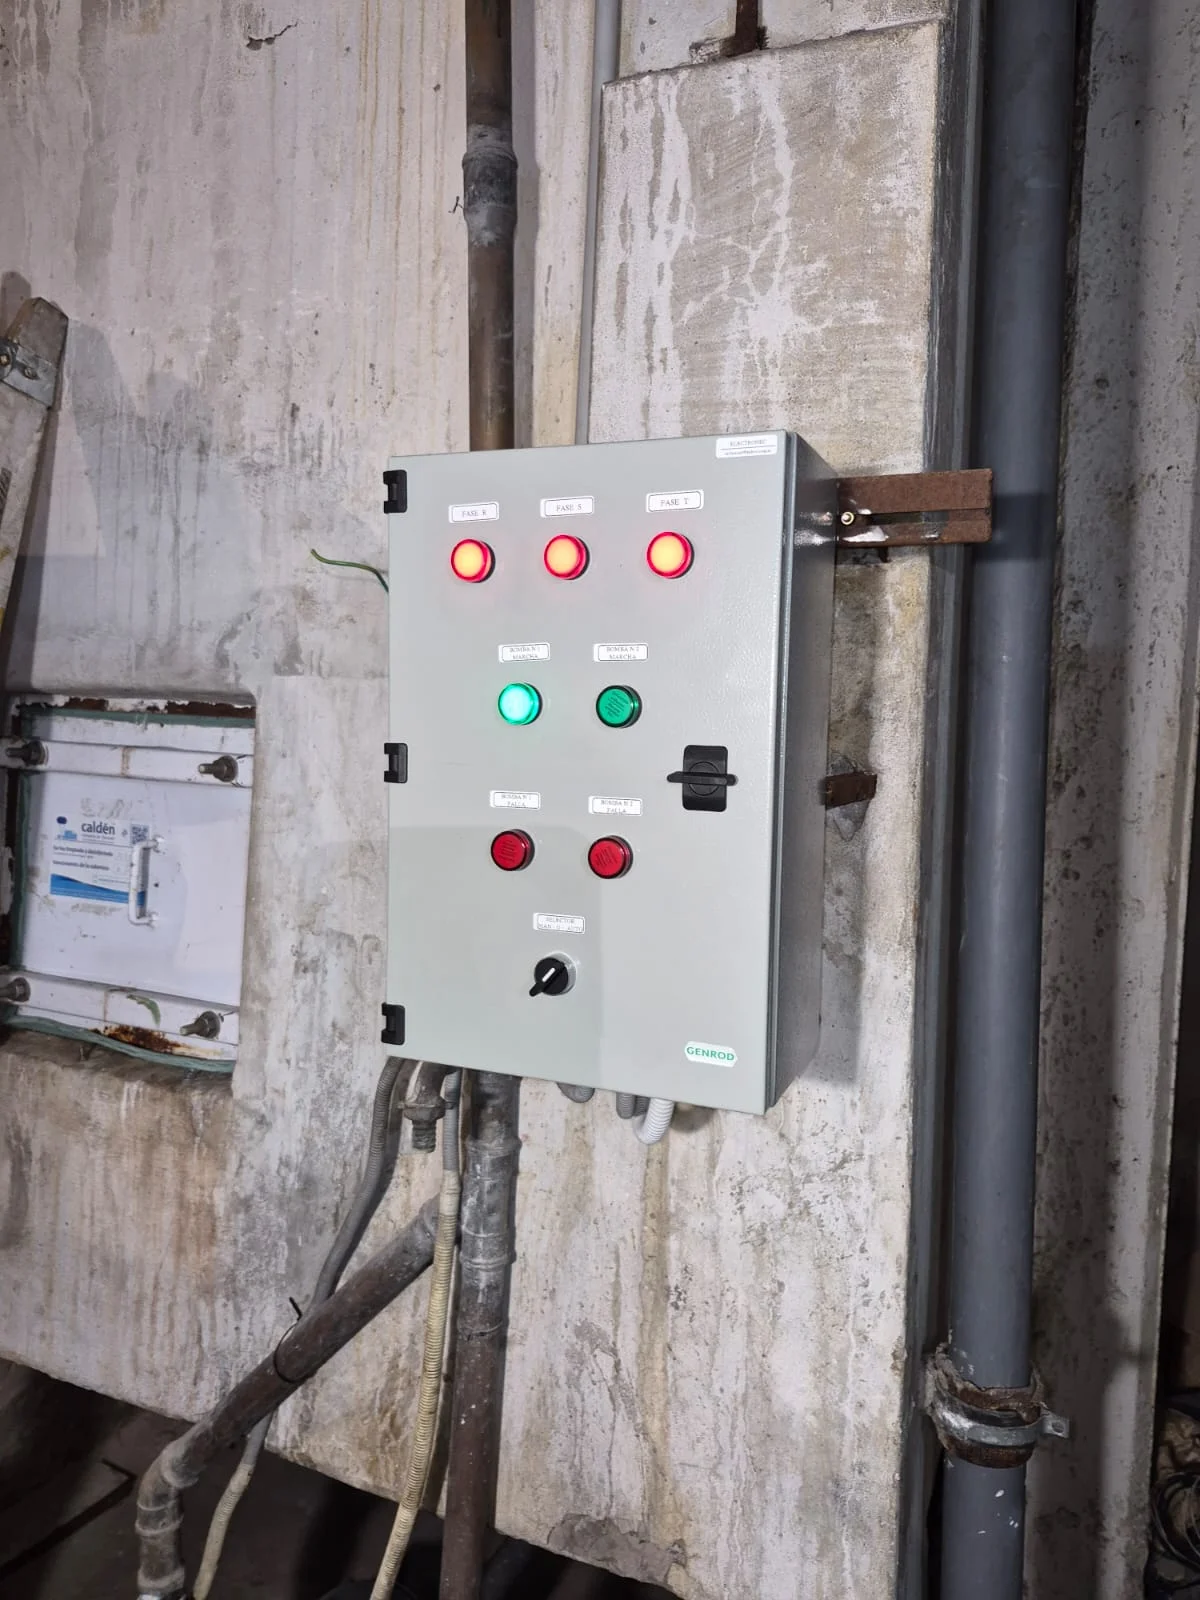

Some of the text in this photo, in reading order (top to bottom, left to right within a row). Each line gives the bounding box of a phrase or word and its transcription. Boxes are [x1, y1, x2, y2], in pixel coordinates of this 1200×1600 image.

[556, 504, 575, 512] FASE
[661, 498, 680, 507] FASE
[81, 821, 116, 835] caldén
[686, 1046, 735, 1061] GENROD
